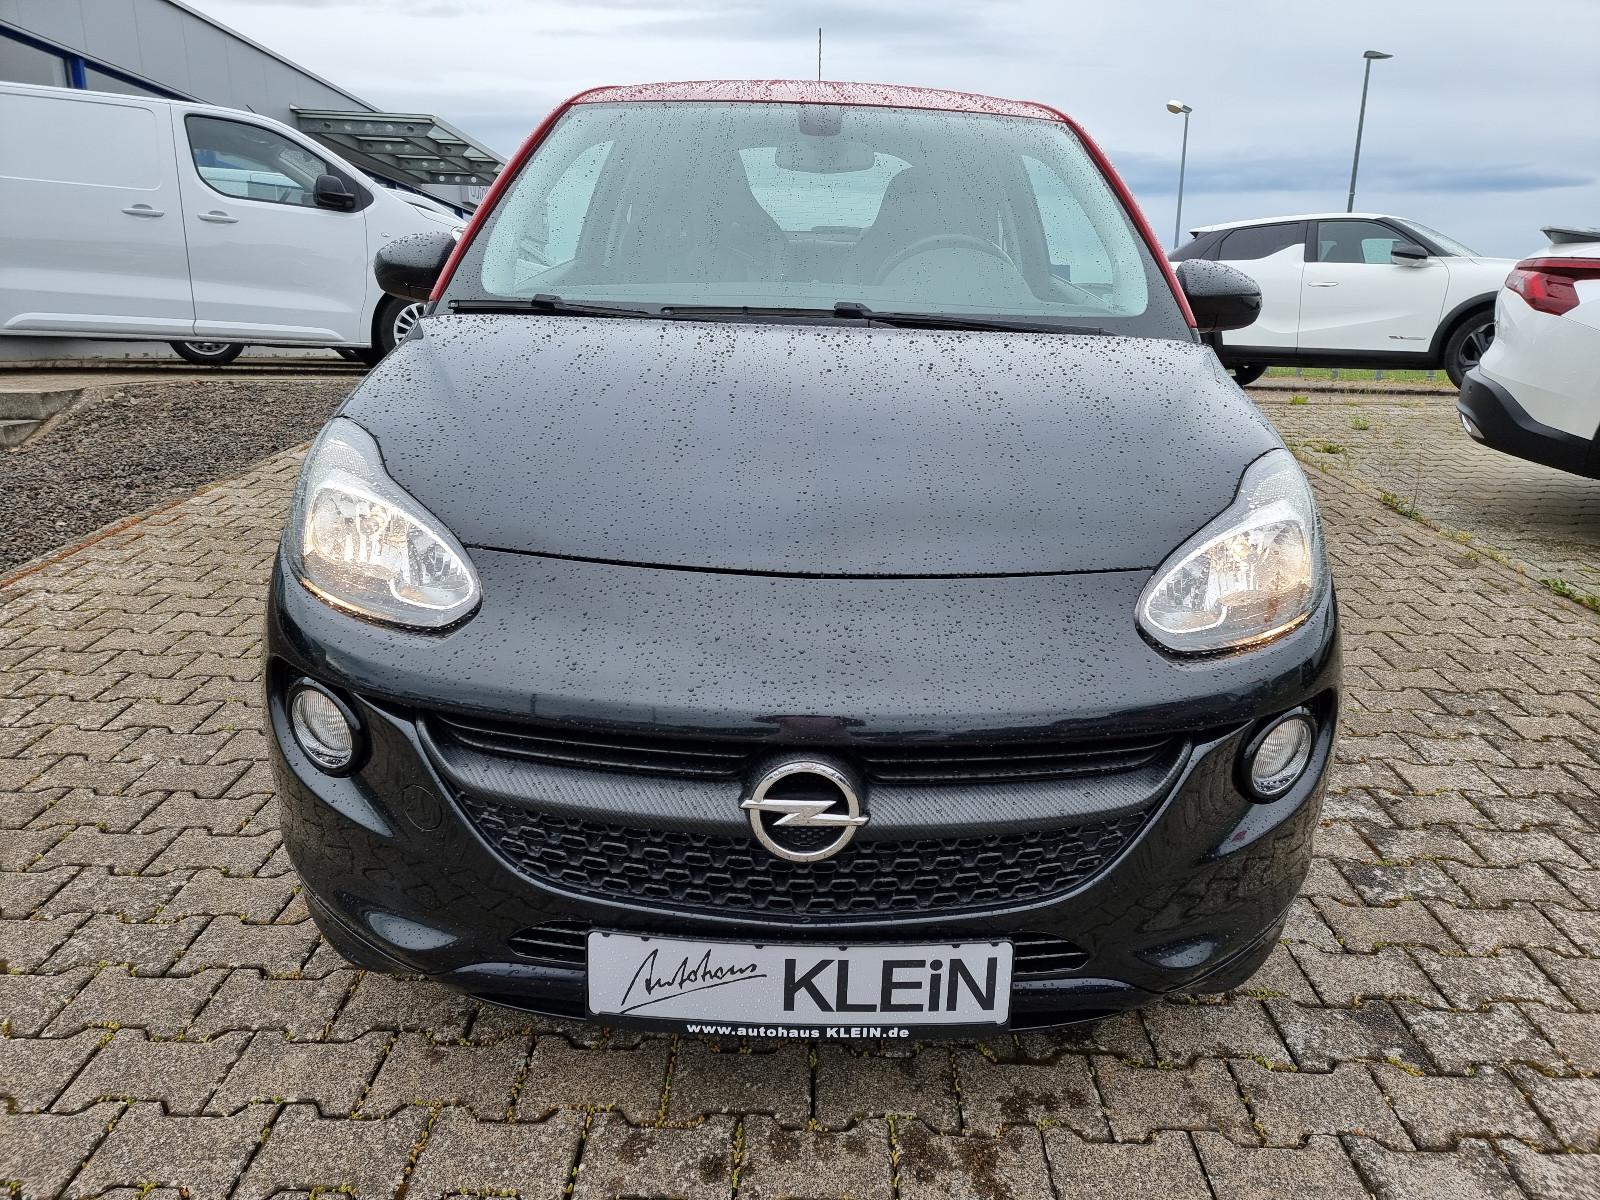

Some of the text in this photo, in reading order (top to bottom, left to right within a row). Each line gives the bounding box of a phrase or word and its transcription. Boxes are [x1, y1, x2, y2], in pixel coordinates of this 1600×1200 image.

[621, 948, 758, 1006] Autohaus
[686, 1024, 909, 1038] www.autohaus KLEIN.de
